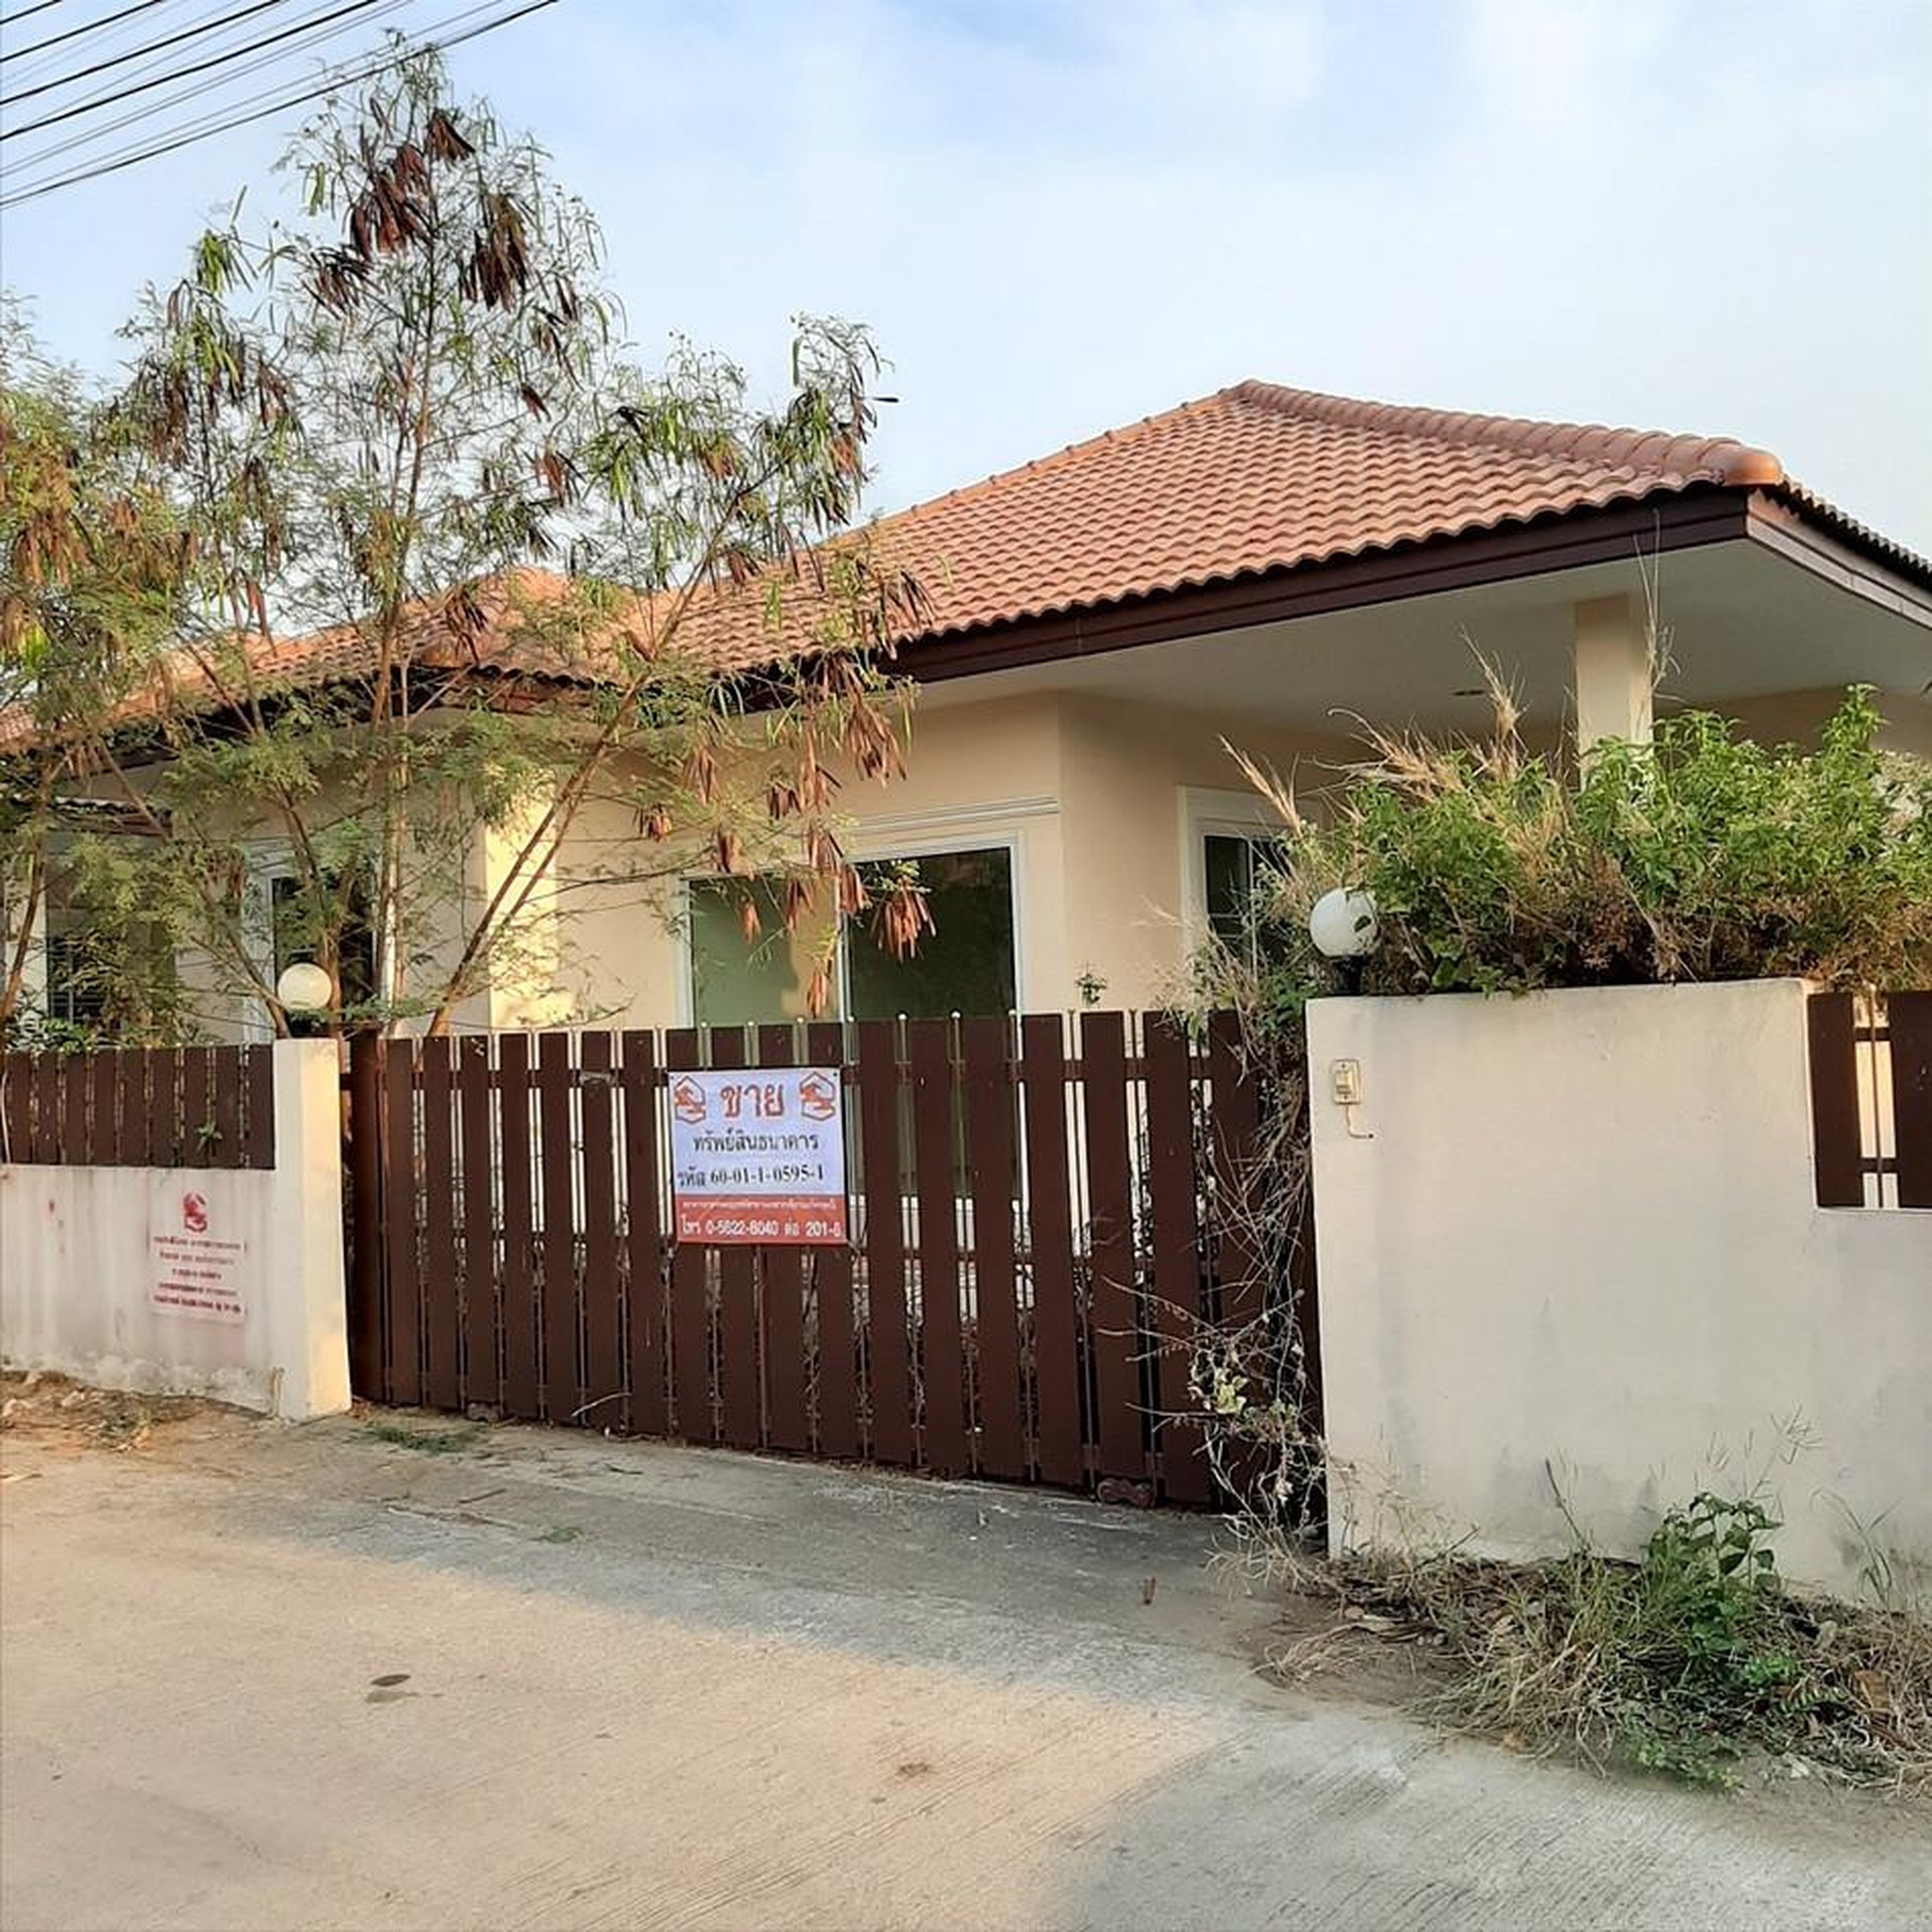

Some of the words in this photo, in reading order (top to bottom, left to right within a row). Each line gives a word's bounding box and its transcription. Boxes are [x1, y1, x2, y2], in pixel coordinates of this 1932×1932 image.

[721, 1084, 784, 1117] ขาย
[693, 1128, 819, 1152] ทรัพย์สินธนาคาร
[677, 1166, 706, 1188] รหัส
[710, 1164, 824, 1185] 60-01-1-0595-1
